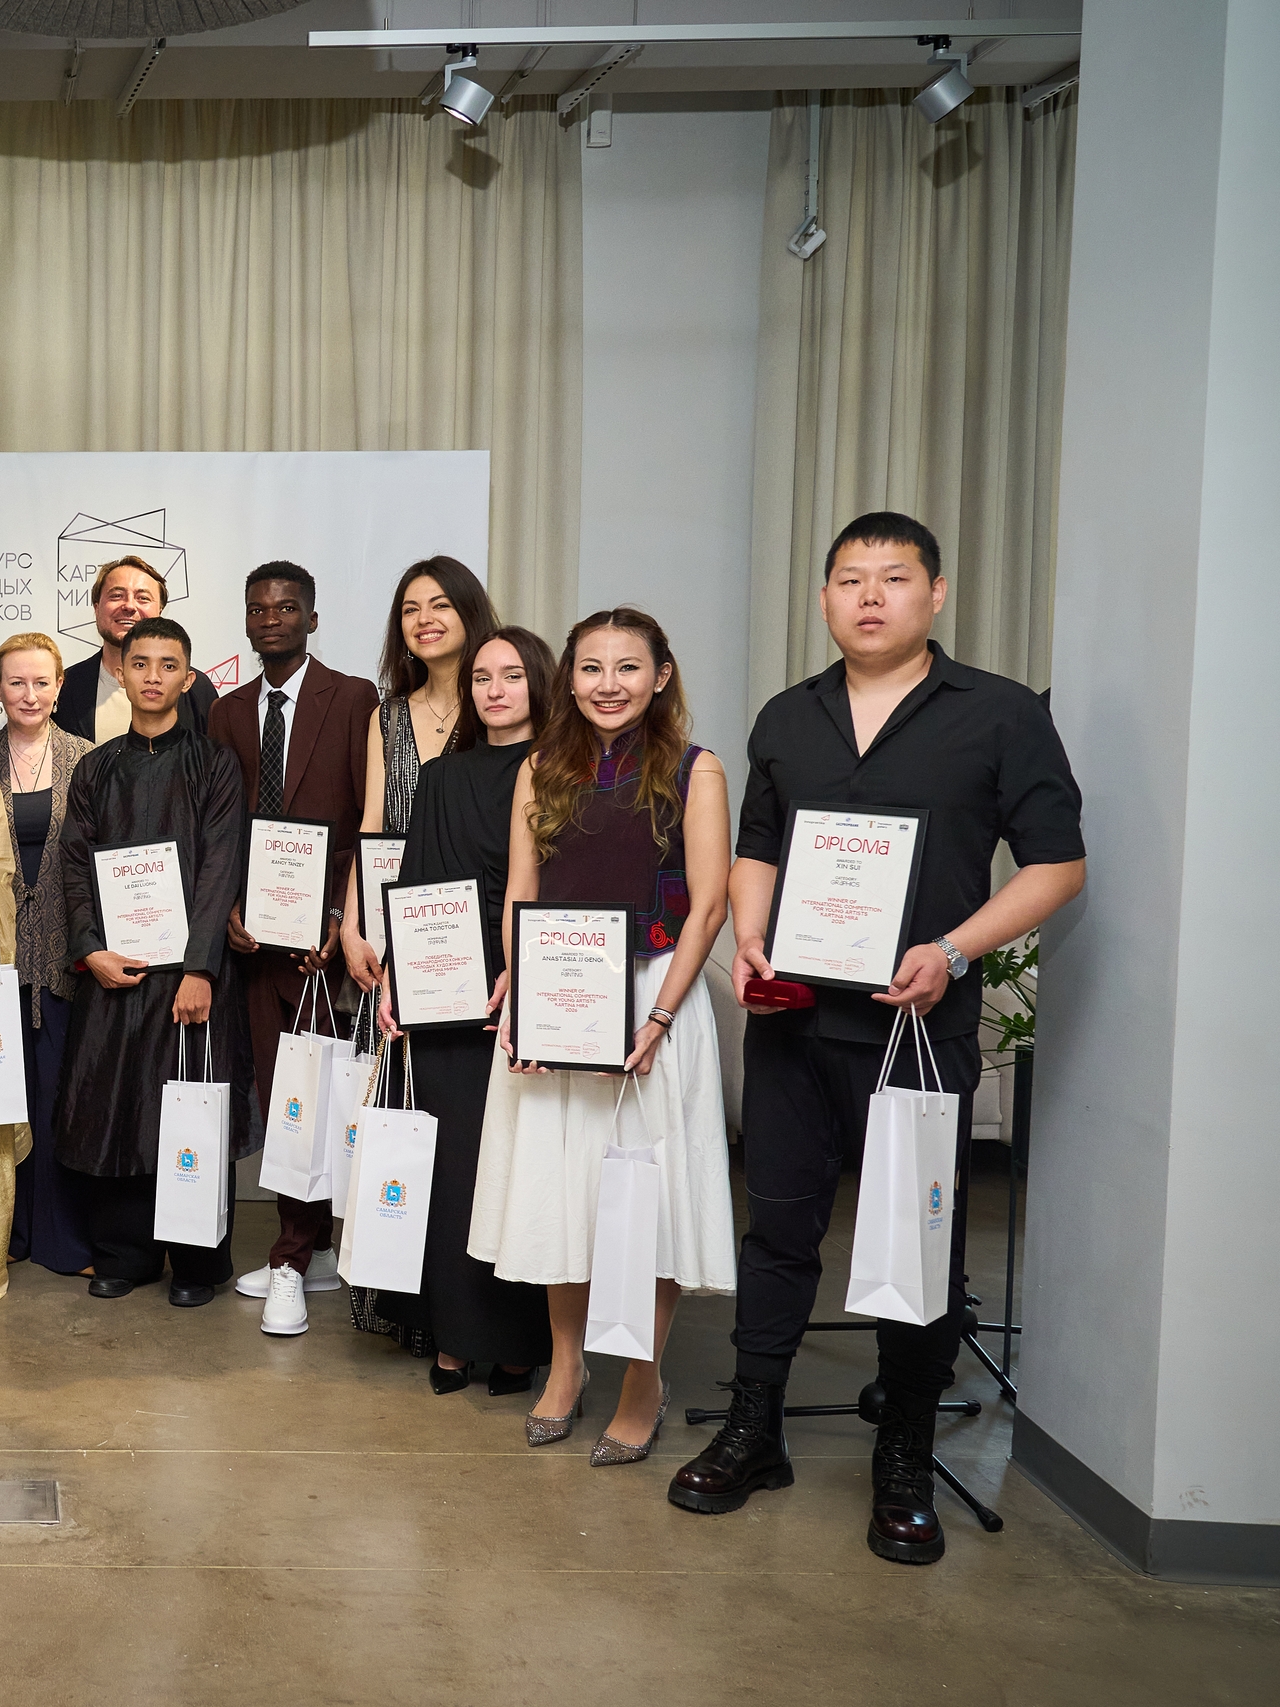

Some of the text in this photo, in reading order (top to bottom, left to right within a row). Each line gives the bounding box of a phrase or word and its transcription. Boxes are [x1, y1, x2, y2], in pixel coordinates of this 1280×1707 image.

[57, 589, 93, 607] МИ
[265, 839, 312, 855] DIPLOMa
[814, 835, 890, 855] DIPLOMa
[112, 861, 164, 878] DIPLOMa
[373, 857, 402, 869] ДИП
[403, 901, 468, 919] ДИПЛОМ
[801, 900, 882, 913] INTERNATIONAL COMPETITION
[376, 1207, 407, 1215] САМАРСКАЯ
[379, 1212, 403, 1220] ОБЛАСТЬ
